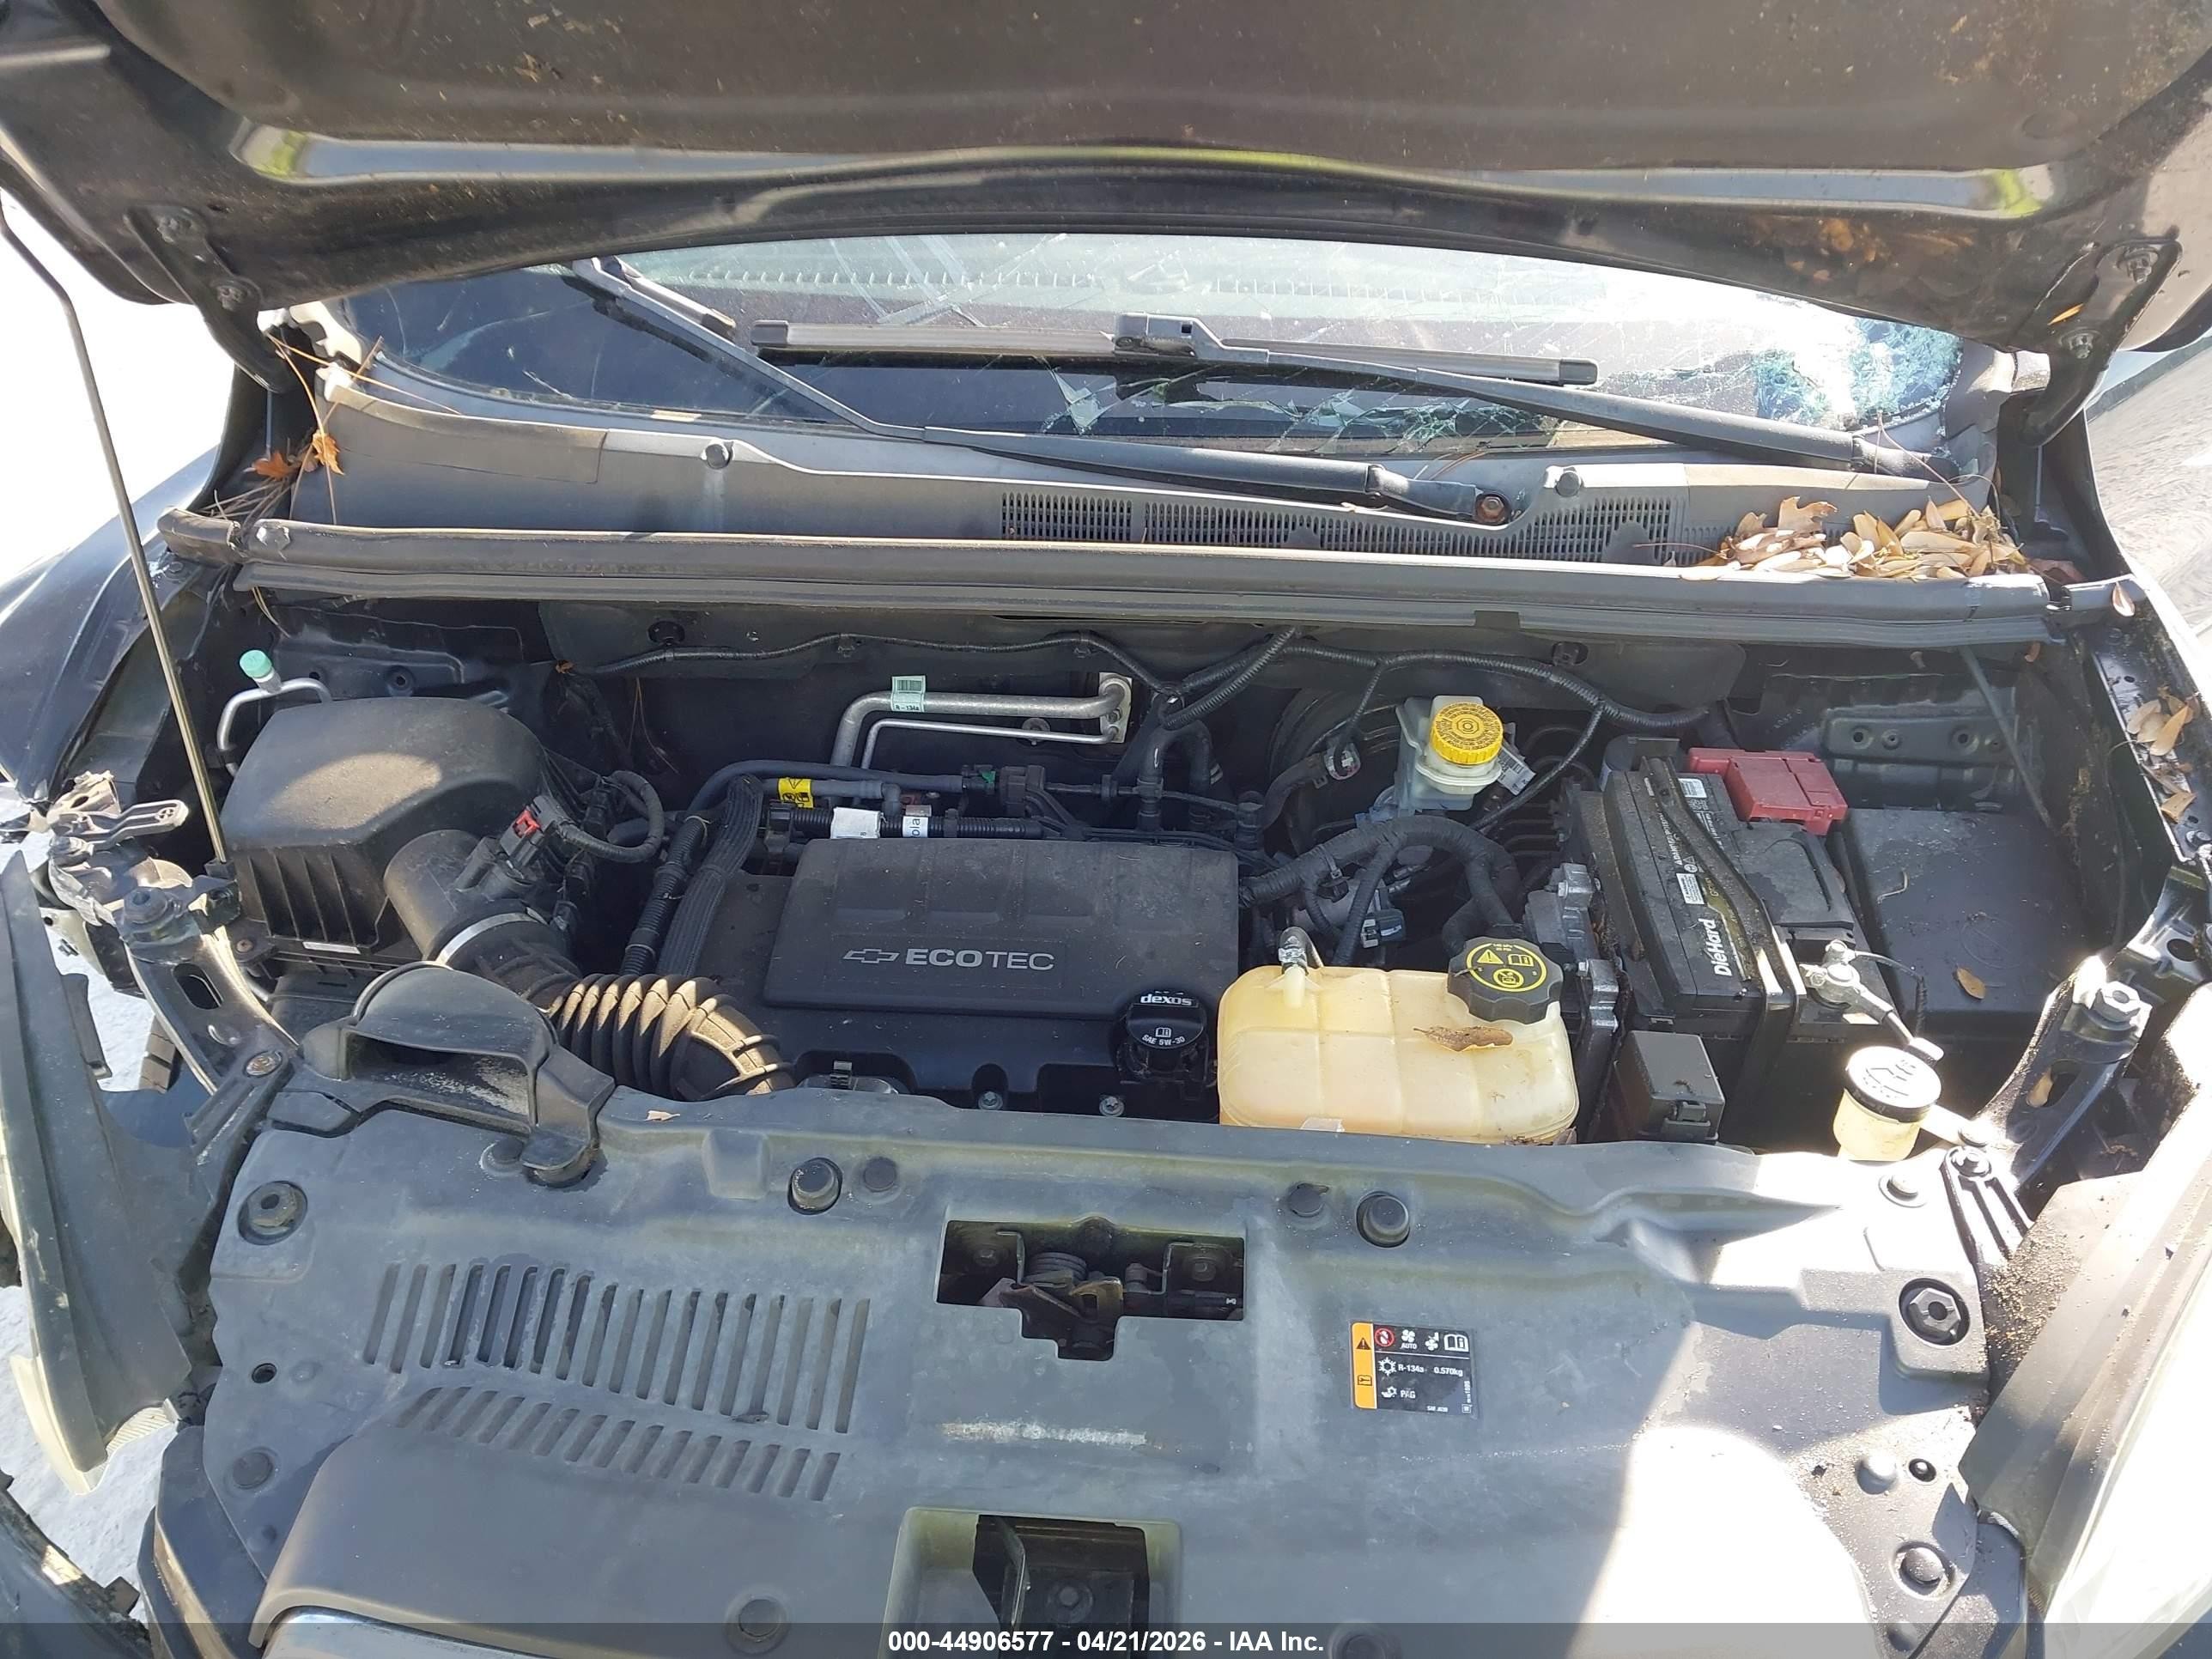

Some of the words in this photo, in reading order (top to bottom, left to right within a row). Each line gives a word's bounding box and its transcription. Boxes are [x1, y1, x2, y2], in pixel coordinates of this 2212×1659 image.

[1698, 918, 1733, 977] DieHard
[905, 947, 1055, 971] ECOTEC
[1139, 993, 1193, 1006] dexos
[1141, 1034, 1158, 1045] SAE
[1158, 1036, 1186, 1046] 5W-30
[1400, 1342, 1418, 1351] AUTO
[1397, 1364, 1425, 1373] R-134a
[1433, 1367, 1463, 1377] 0.570kg
[1400, 1389, 1417, 1400] PAG
